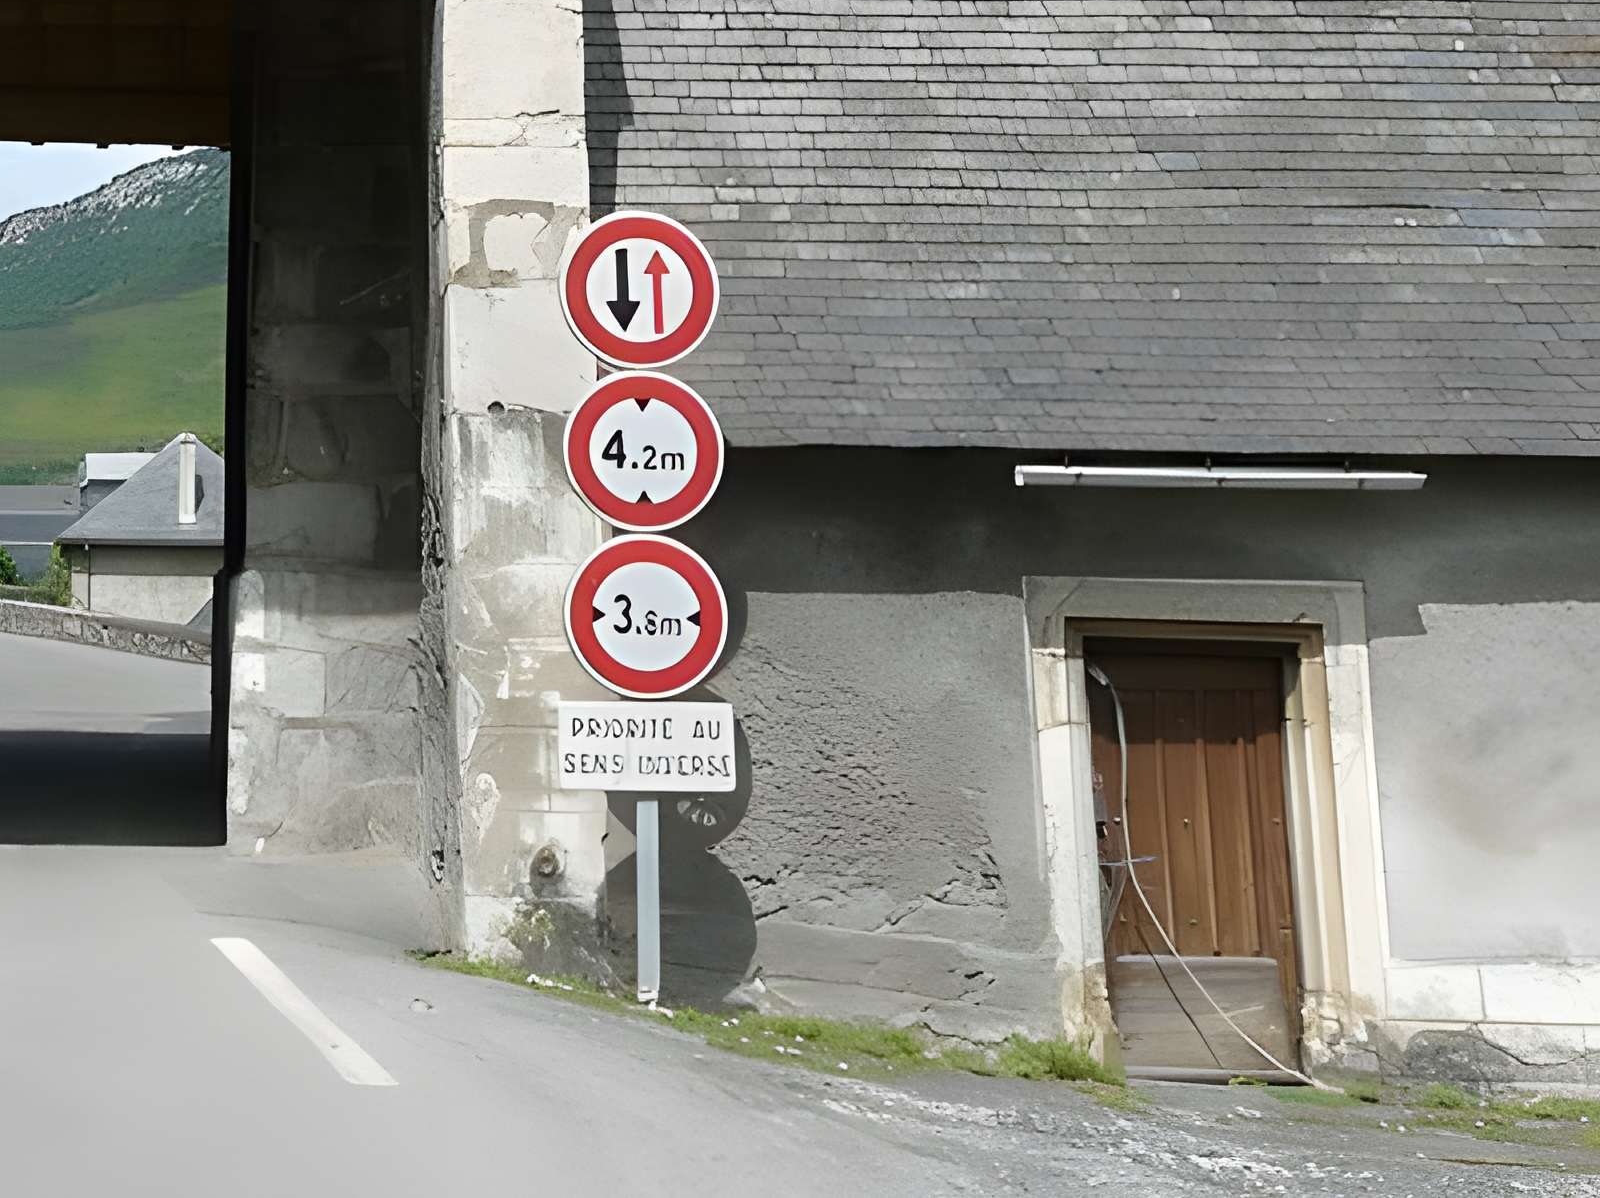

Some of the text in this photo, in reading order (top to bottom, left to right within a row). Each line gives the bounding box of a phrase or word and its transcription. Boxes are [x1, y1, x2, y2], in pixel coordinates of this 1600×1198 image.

[601, 429, 685, 470] 4.2m
[692, 721, 720, 740] AU
[564, 753, 625, 774] SENS
